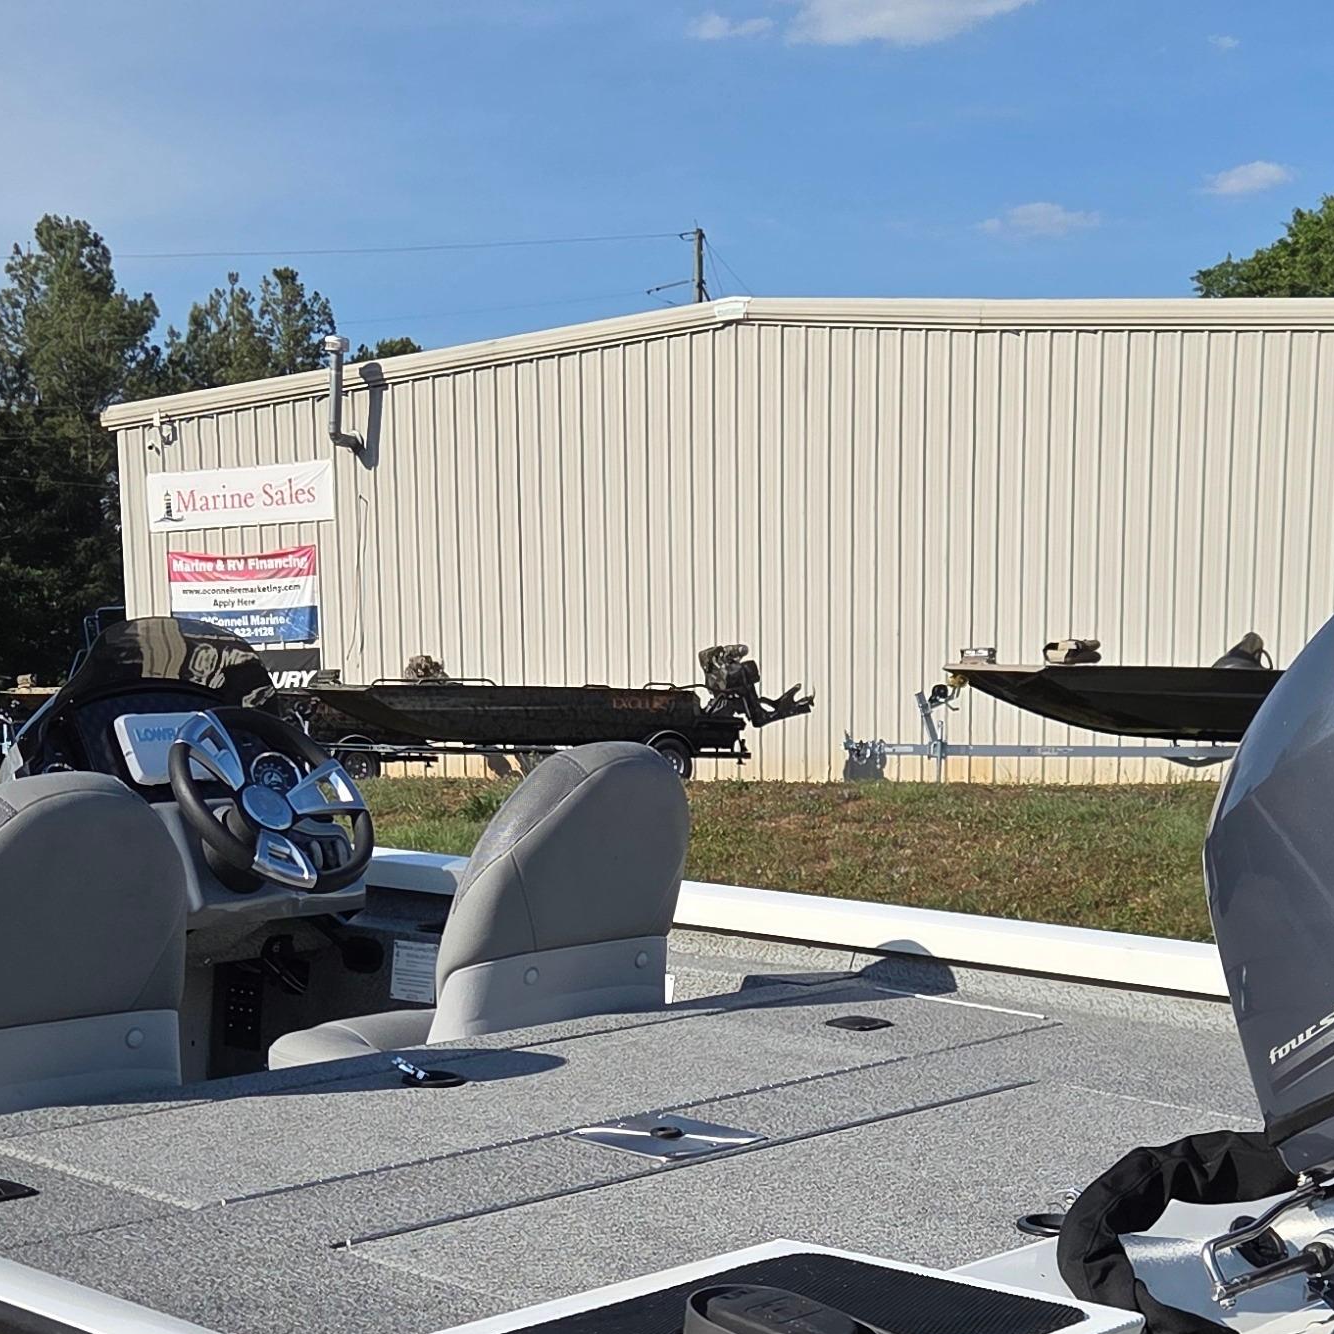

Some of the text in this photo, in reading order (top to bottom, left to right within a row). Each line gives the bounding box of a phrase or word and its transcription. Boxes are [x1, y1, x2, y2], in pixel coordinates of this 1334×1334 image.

[176, 478, 316, 513] Marine Sales
[172, 555, 308, 572] Marine & RV Financing
[213, 598, 256, 608] Apply Here
[250, 614, 285, 625] Marine
[268, 670, 317, 689] URY
[133, 726, 177, 741] LOWR
